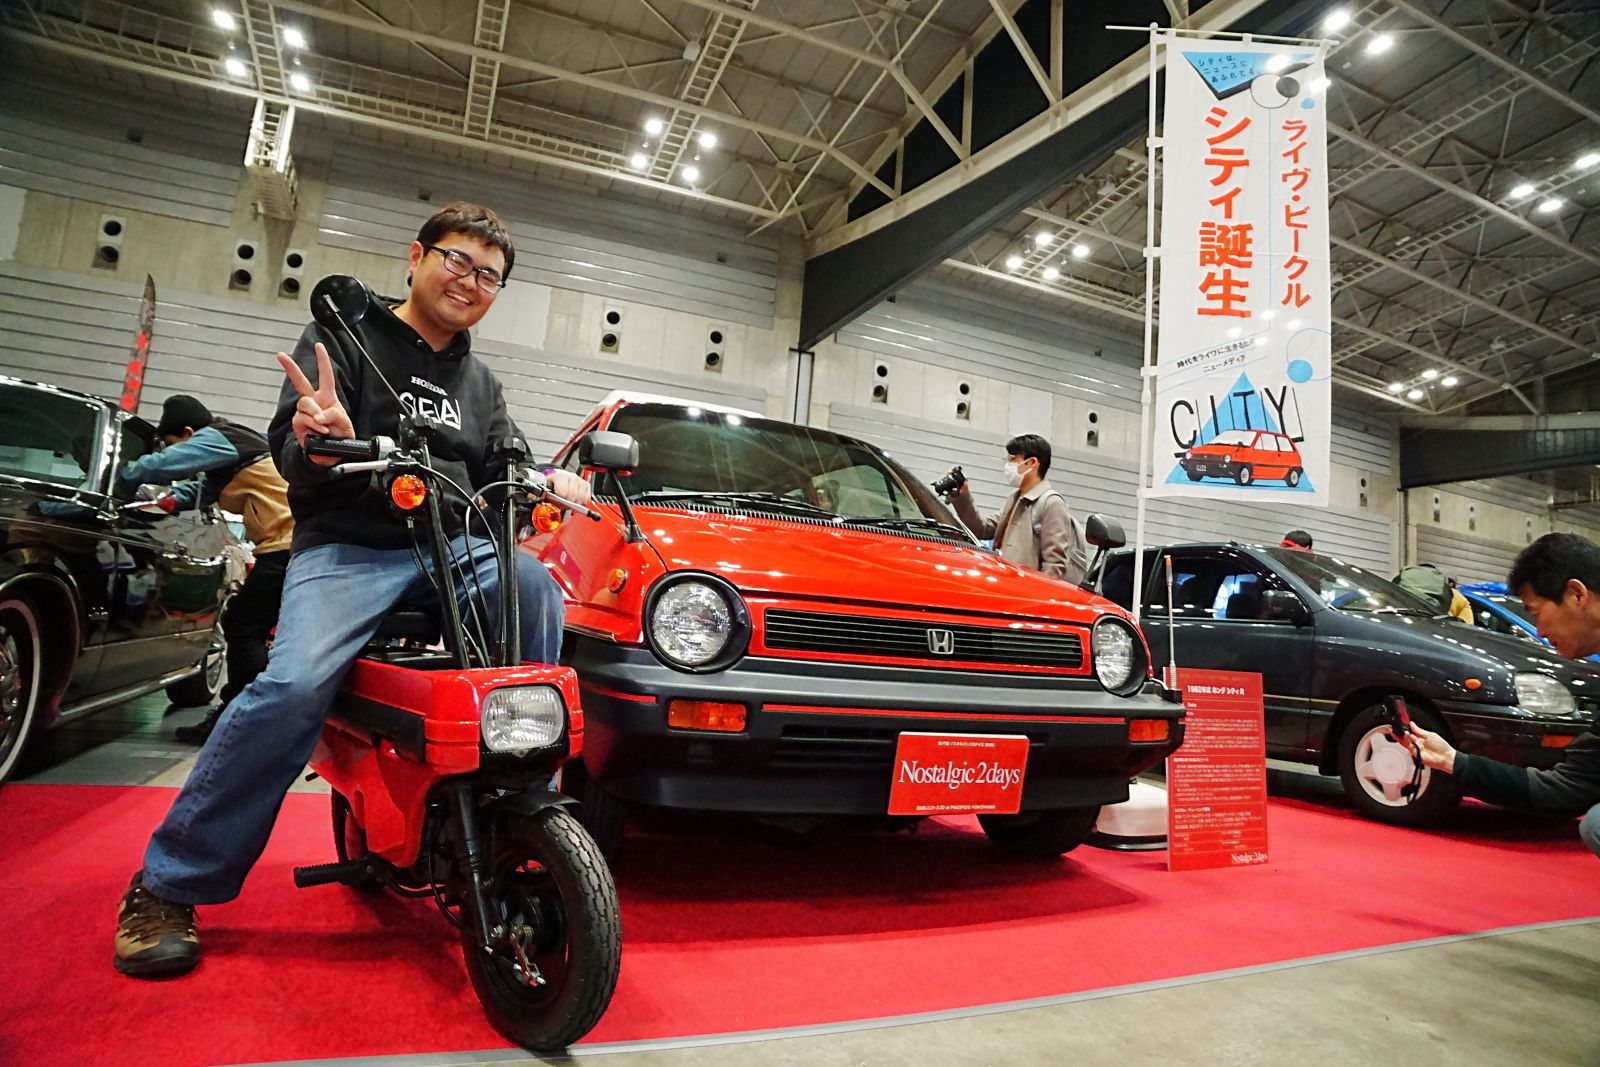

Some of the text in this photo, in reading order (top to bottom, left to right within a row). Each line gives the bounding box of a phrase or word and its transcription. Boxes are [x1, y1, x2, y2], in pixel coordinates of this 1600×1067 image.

[1198, 106, 1253, 318] シティ誕生
[1281, 119, 1311, 308] ライヴ・ビークル
[1203, 354, 1246, 372] ニューメディア
[410, 375, 448, 396] HONDA
[898, 760, 1020, 790] Nostalgic 2days
